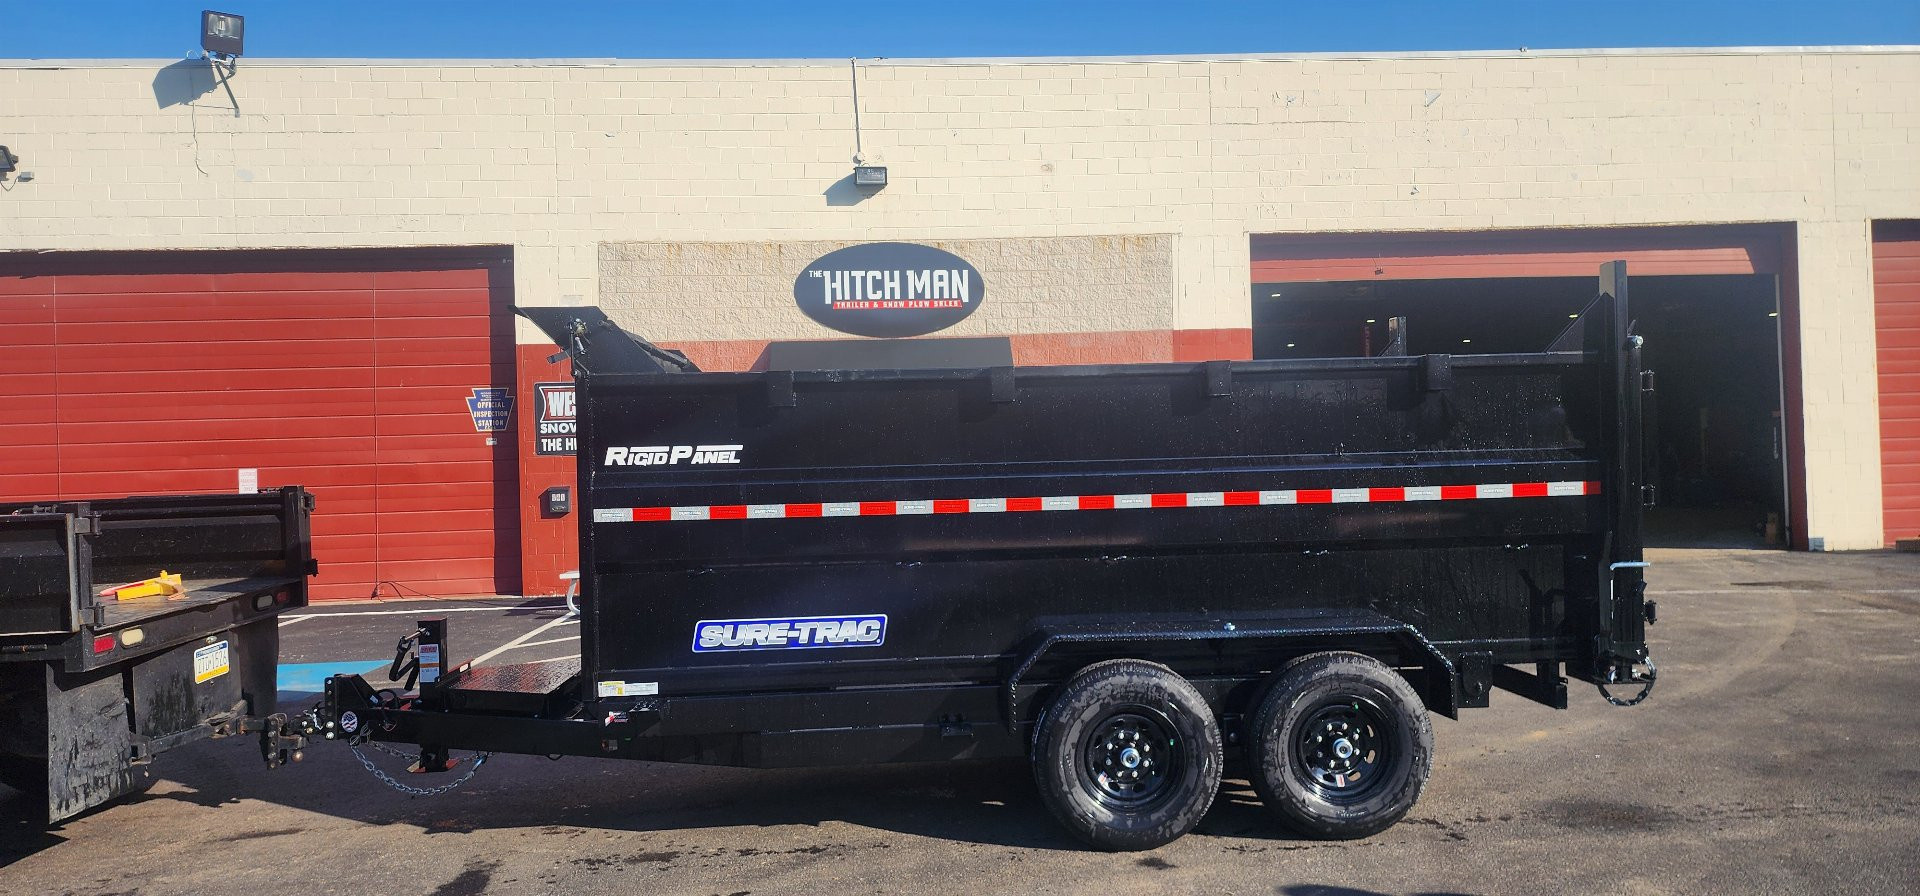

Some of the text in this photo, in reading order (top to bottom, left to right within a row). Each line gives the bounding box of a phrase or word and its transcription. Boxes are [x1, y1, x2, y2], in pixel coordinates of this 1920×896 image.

[809, 269, 969, 305] THE HITCH MAN
[836, 301, 869, 309] TRAILER
[908, 300, 930, 308] PLOW
[933, 300, 959, 308] SALES
[477, 401, 505, 409] OFFICIAL
[473, 410, 508, 418] INSPECTION
[477, 419, 504, 427] STATION
[541, 437, 563, 451] THE
[604, 444, 743, 466] RIGID PANEL
[699, 619, 881, 647] SURE-TRAC
